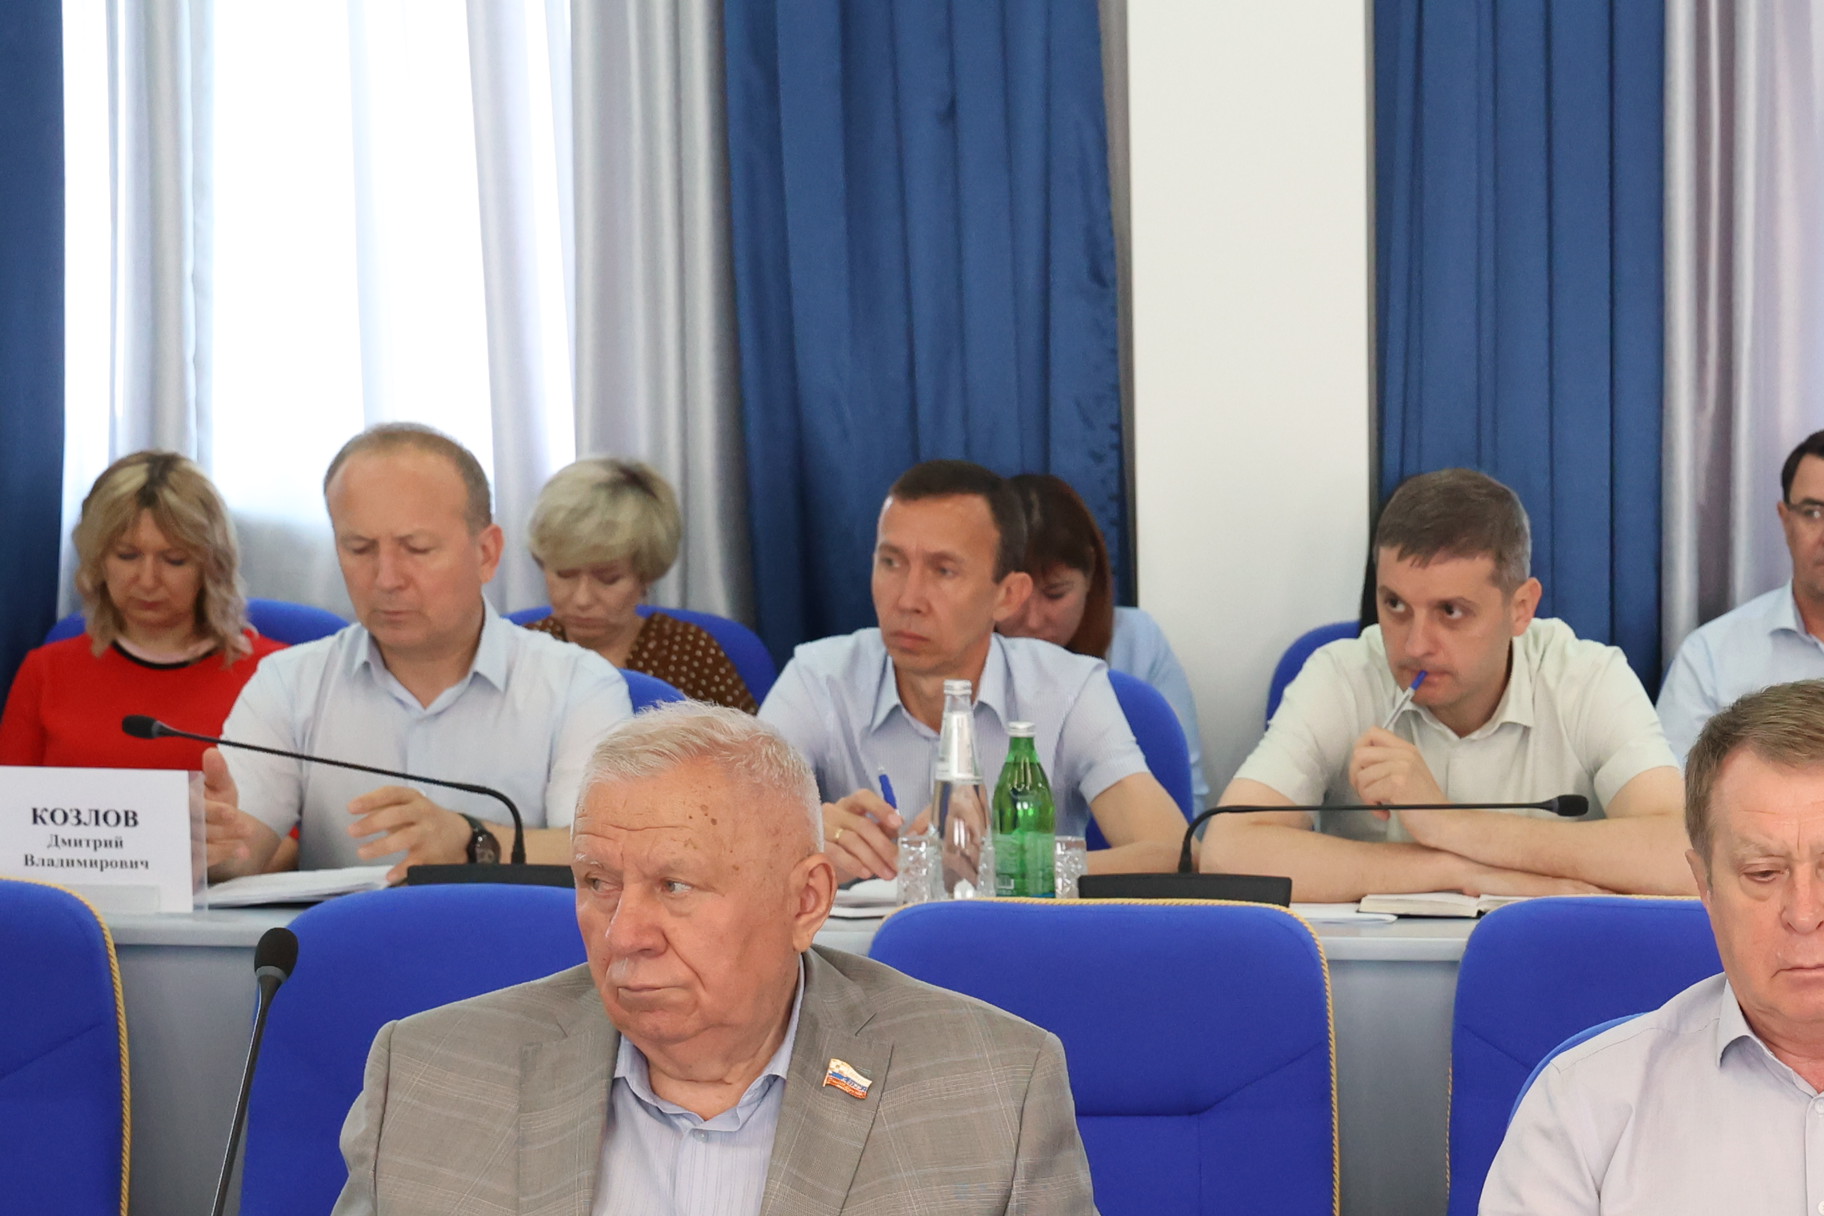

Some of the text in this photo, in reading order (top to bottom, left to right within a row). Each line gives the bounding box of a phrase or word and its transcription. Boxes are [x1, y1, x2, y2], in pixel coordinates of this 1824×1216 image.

[31, 807, 139, 828] КОЗЛОВ
[47, 834, 124, 852] Дмитрий
[23, 854, 149, 872] Владимирович
